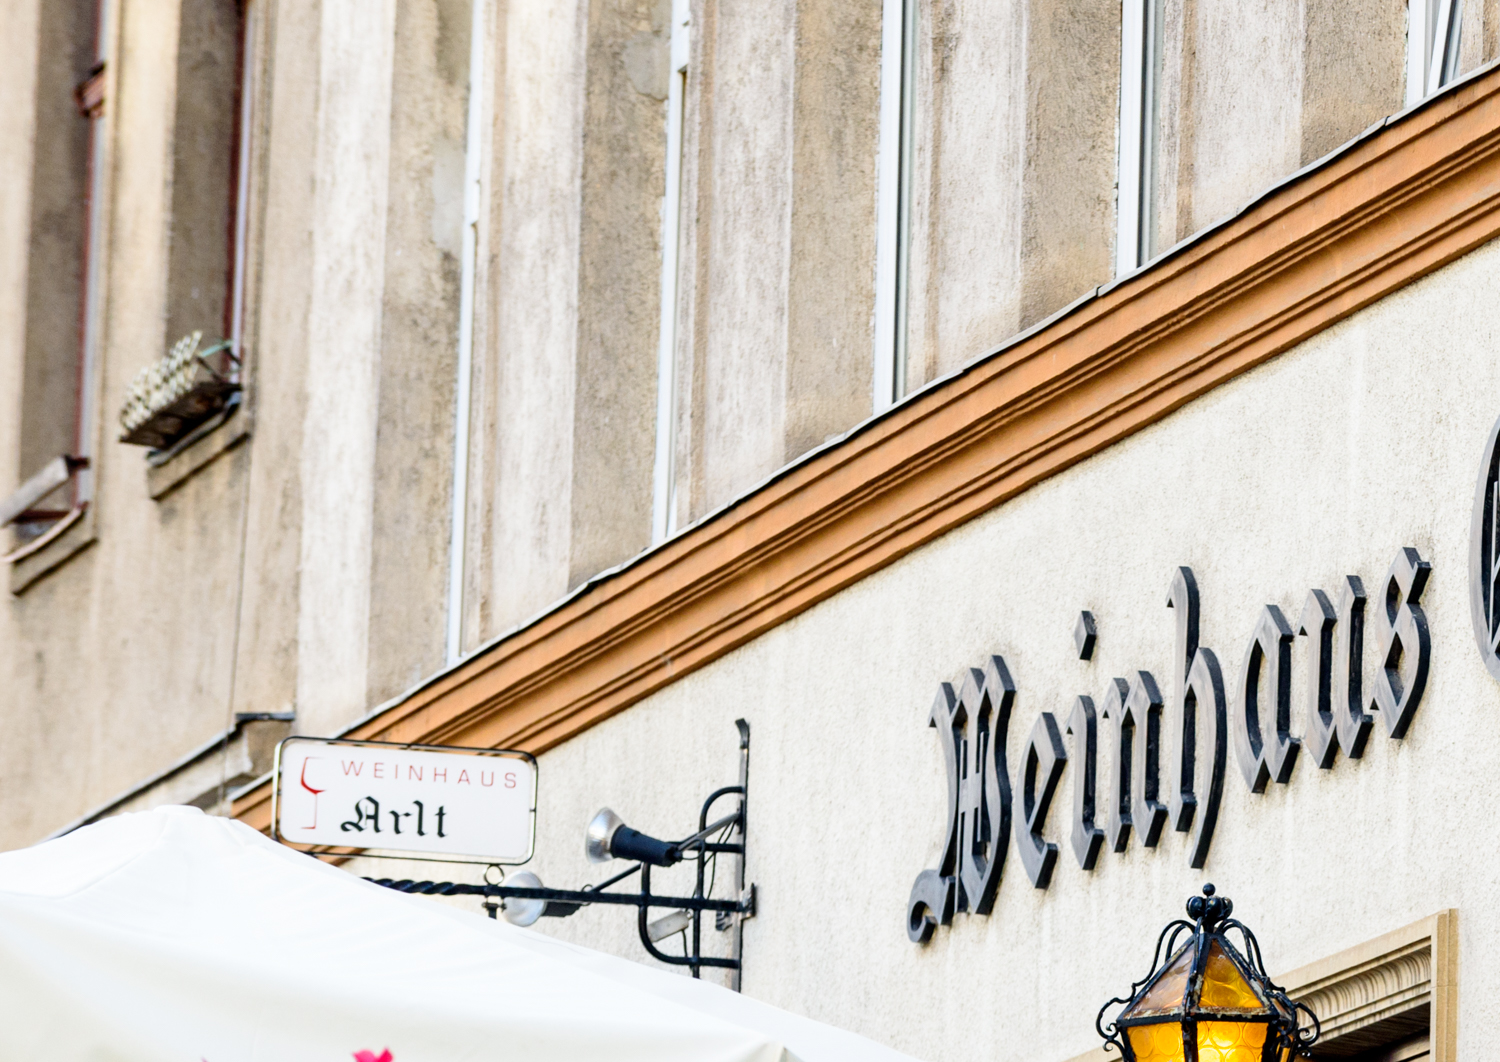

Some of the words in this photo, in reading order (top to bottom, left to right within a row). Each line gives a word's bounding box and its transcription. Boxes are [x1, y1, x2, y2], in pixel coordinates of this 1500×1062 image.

[906, 545, 1432, 943] Weinhaus
[341, 759, 518, 790] WEINHAUS
[339, 796, 449, 839] Arlt
